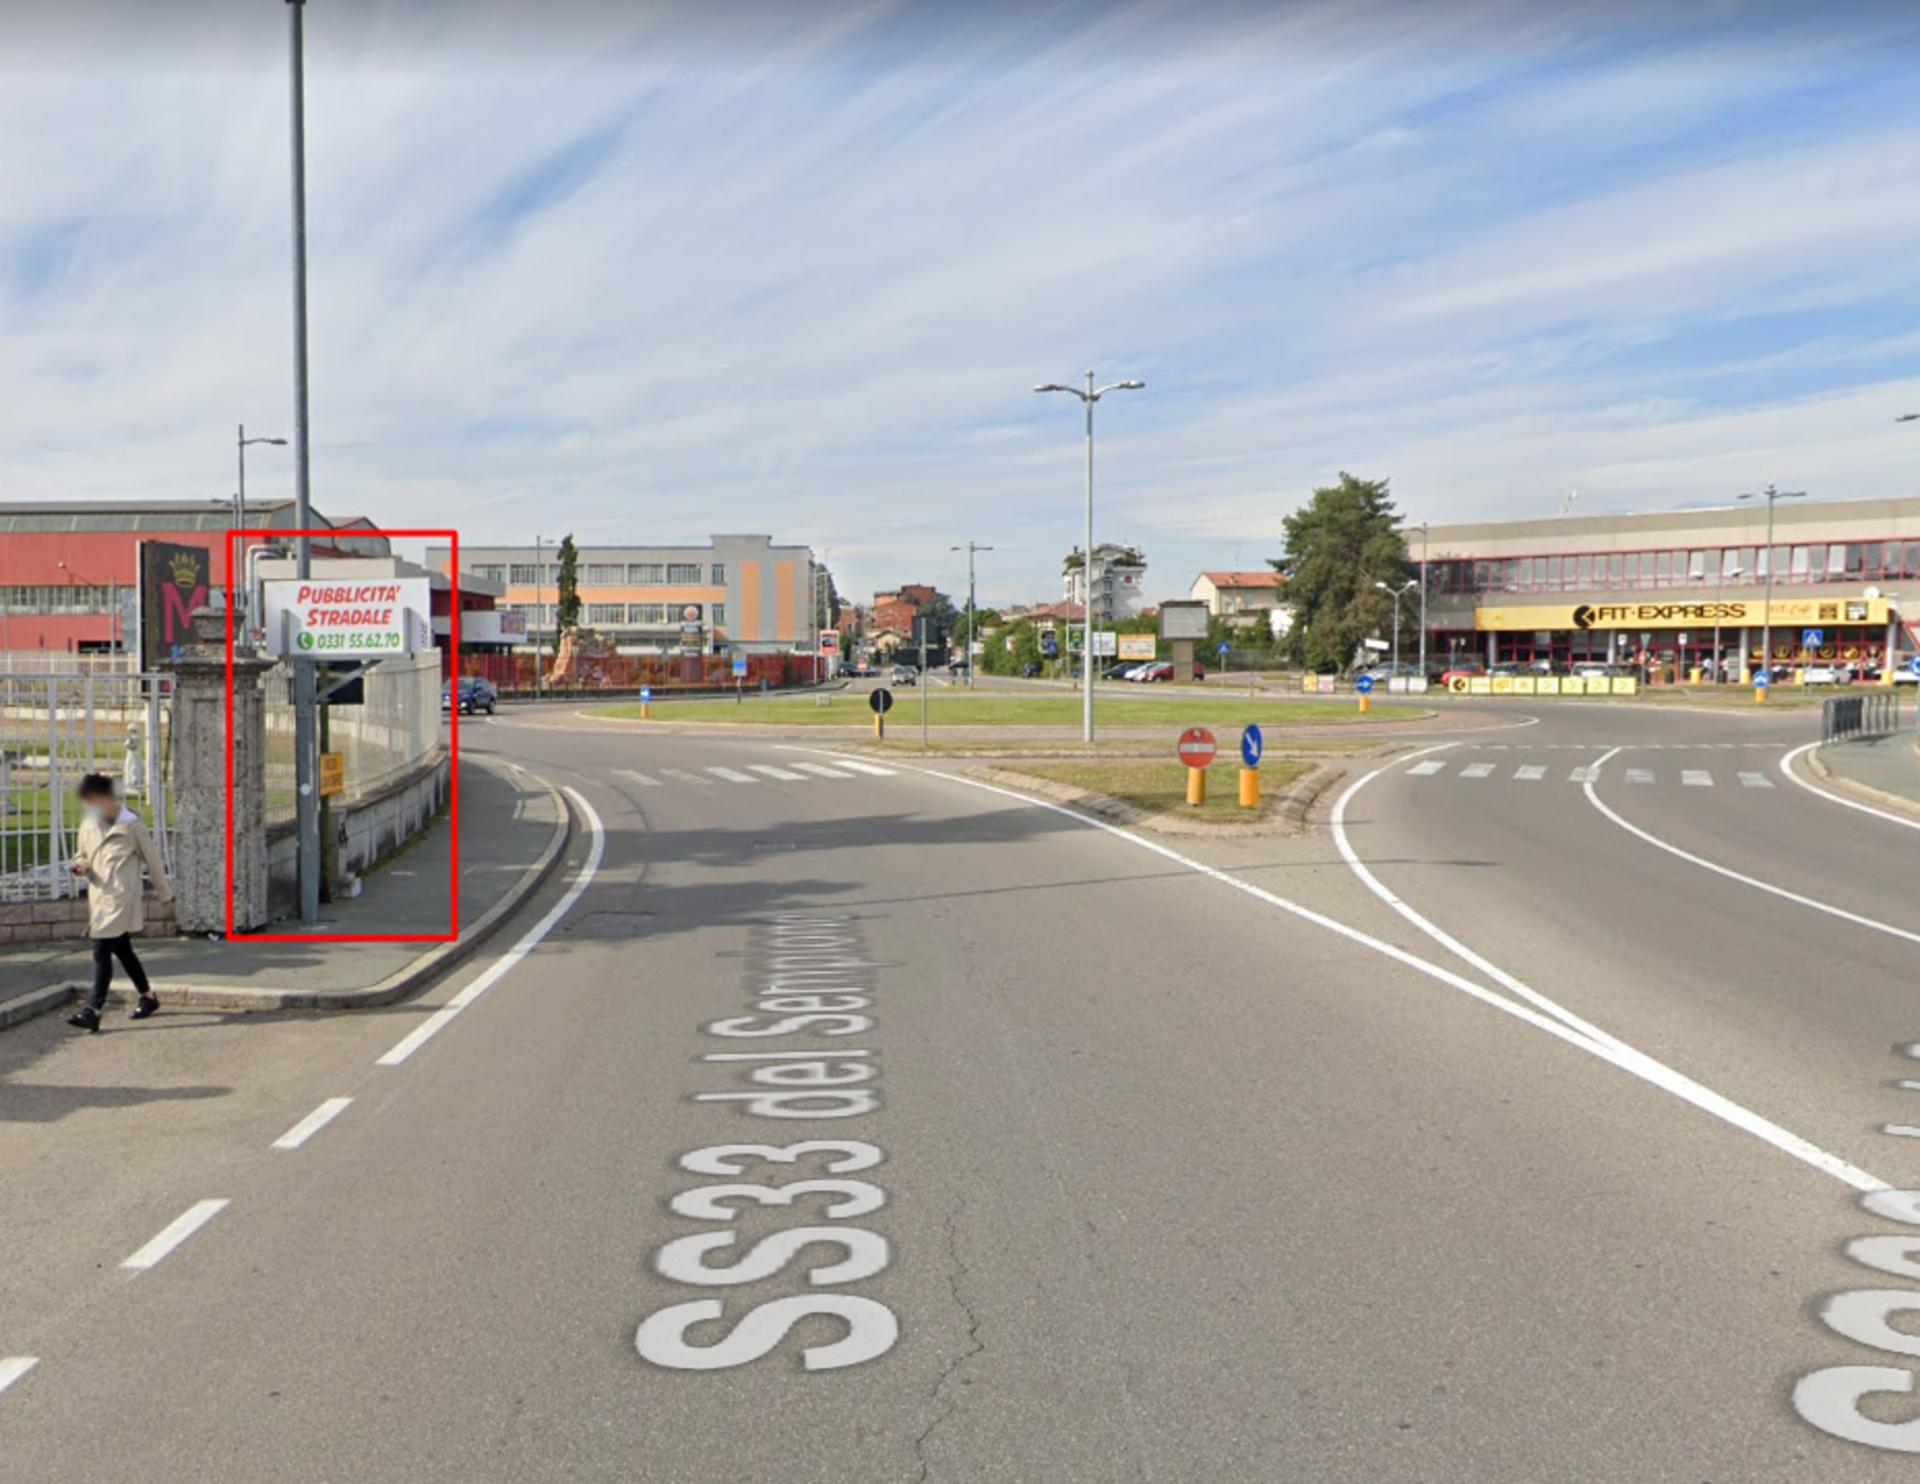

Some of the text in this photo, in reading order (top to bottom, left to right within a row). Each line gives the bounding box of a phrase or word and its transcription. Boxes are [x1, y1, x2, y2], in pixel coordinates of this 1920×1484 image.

[297, 585, 402, 604] PUBBLICITA'
[306, 608, 393, 627] STRADALE
[317, 632, 400, 649] 0331 55.62.70
